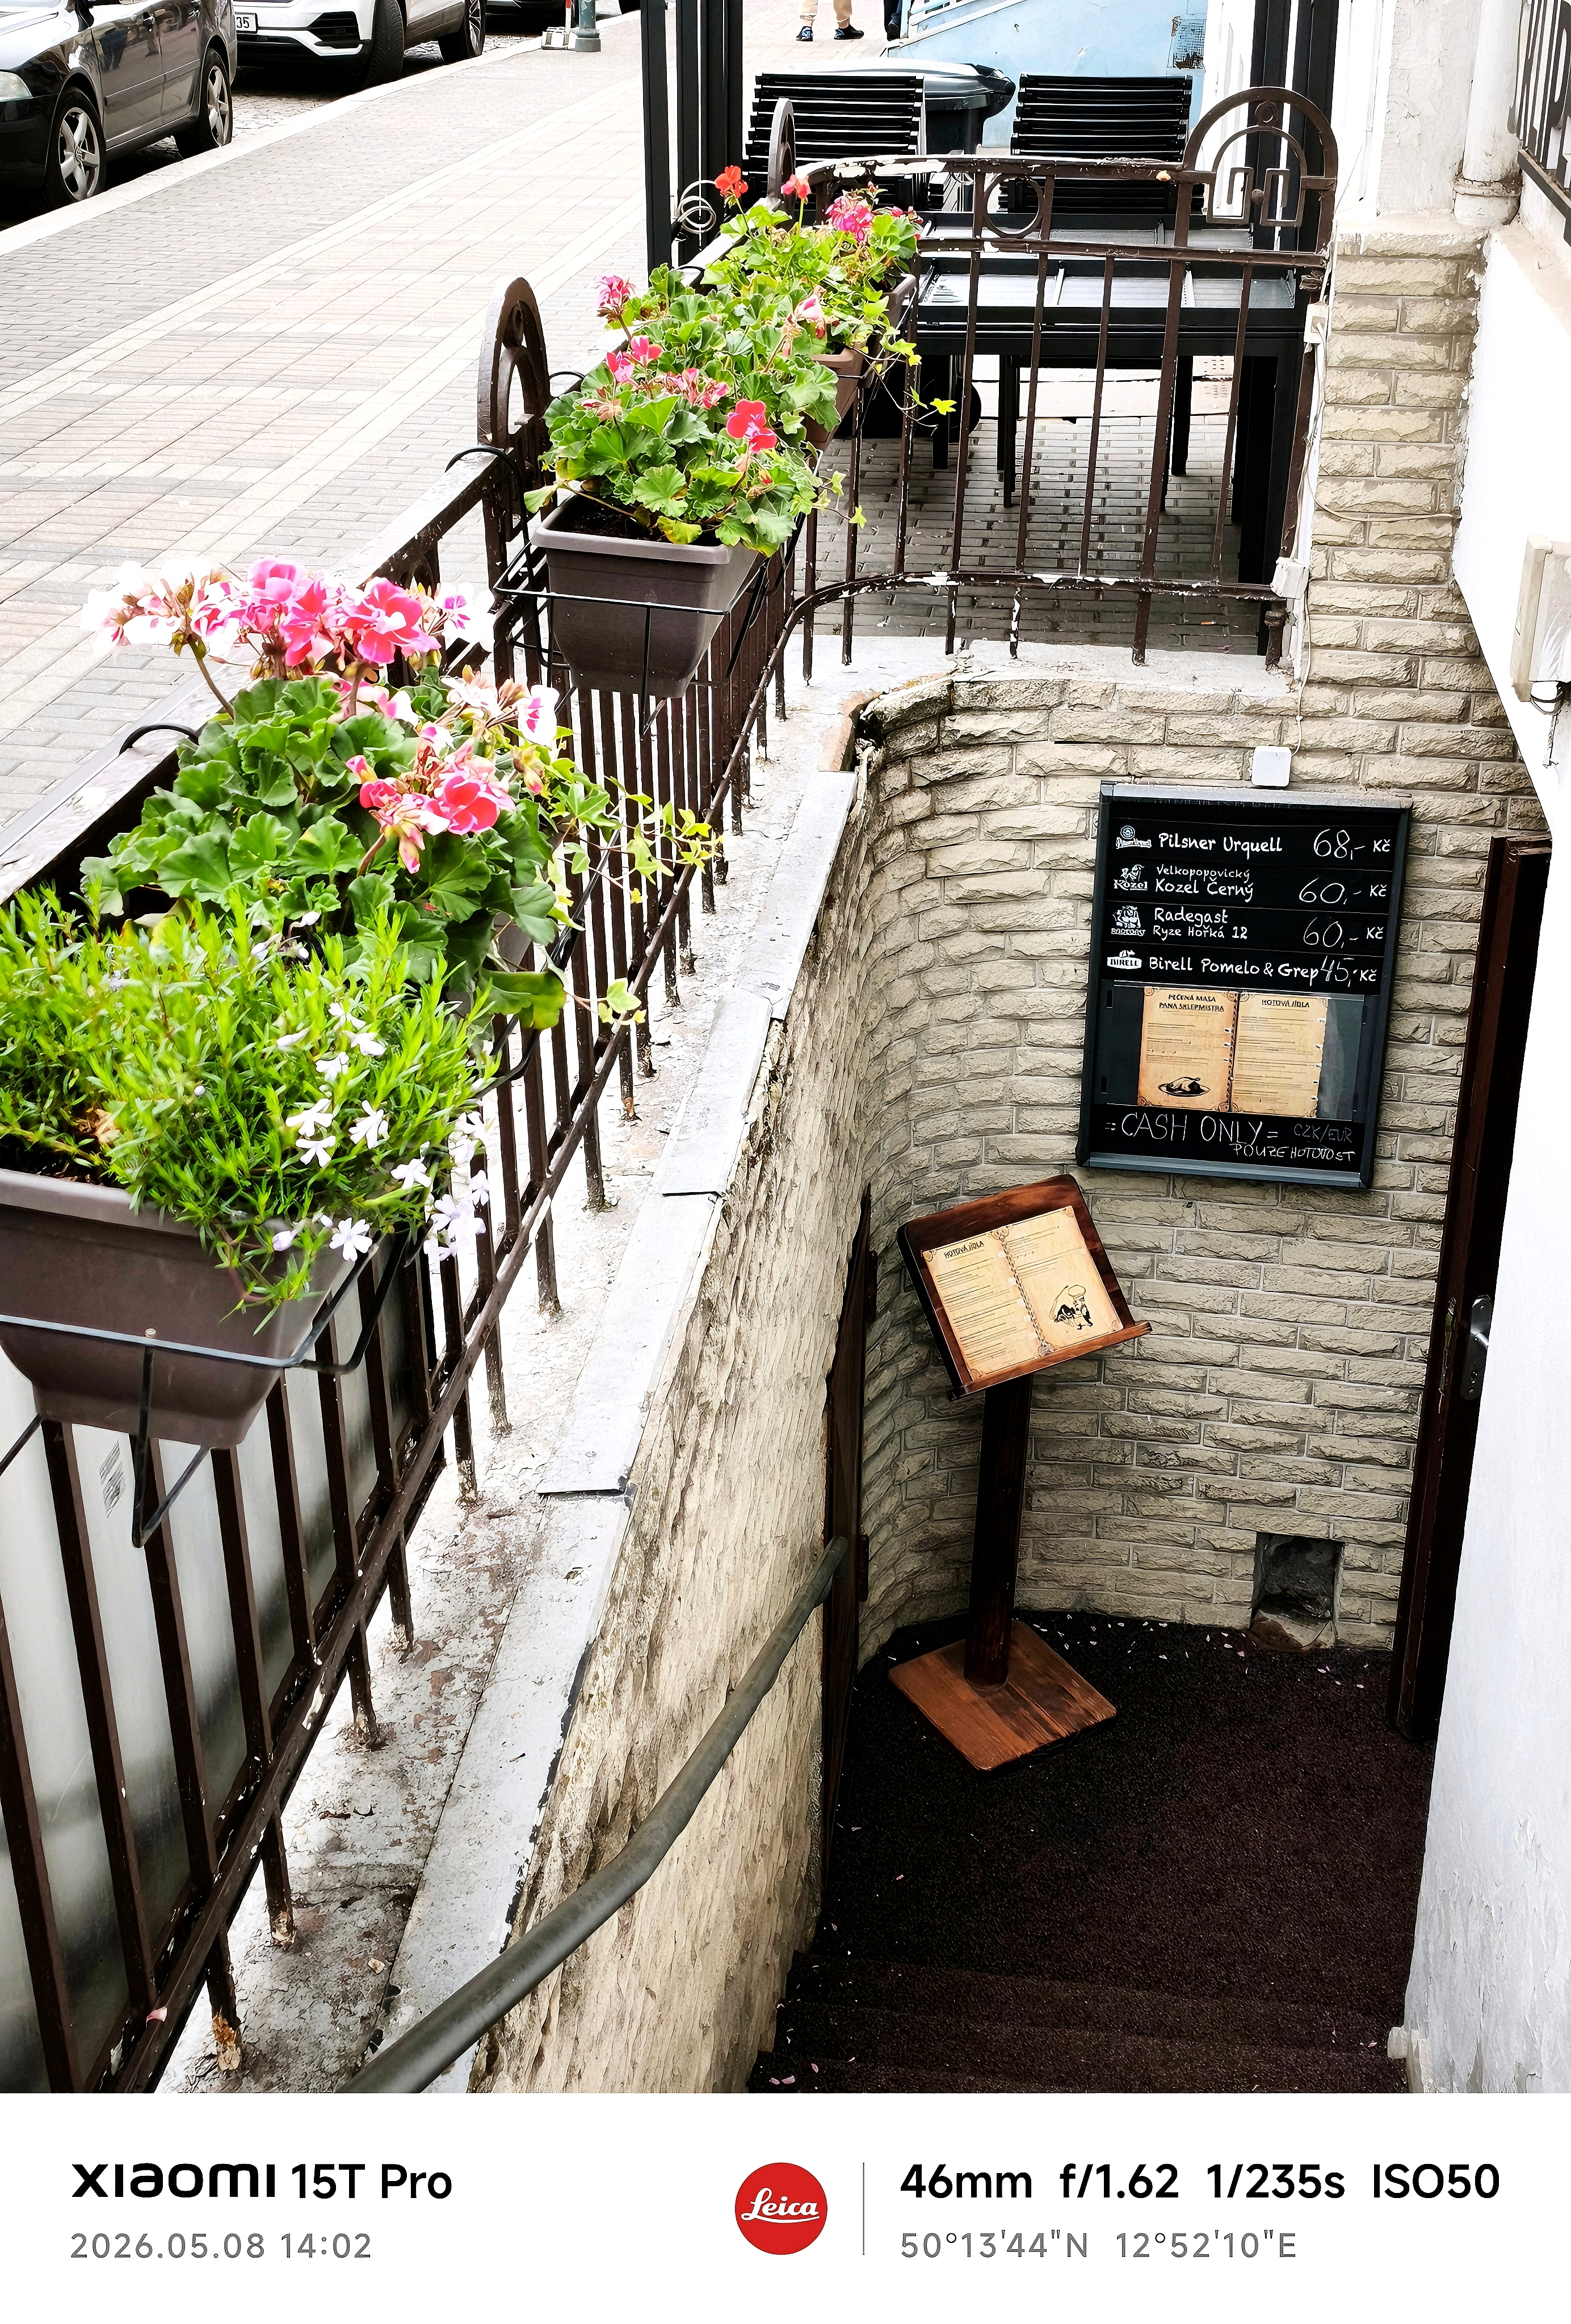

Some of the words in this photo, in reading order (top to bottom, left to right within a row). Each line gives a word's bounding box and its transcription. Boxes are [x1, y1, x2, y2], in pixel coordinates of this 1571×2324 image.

[1158, 832, 1216, 851] Pilsner
[1223, 836, 1283, 860] Urquell
[1373, 839, 1391, 853] Kč
[1156, 864, 1250, 884] Velkopopovický
[1155, 878, 1199, 894] Kozel
[1207, 877, 1254, 903] Černý
[1370, 884, 1387, 897] Kč
[1154, 906, 1228, 928] Radegast
[1153, 925, 1182, 941] Ryze
[1188, 924, 1225, 938] Hořká
[1231, 926, 1247, 940] 12
[1366, 926, 1384, 940] Kč
[1149, 957, 1193, 971] Birell
[1200, 958, 1260, 974] Pomelo
[1263, 962, 1274, 977] &
[1278, 963, 1319, 987] Grep
[1359, 969, 1377, 982] Kč
[1121, 1112, 1187, 1142] CASH
[1200, 1115, 1263, 1146] ONLY
[1293, 1123, 1353, 1144] CZK/EUR
[1229, 1143, 1289, 1157] POUZE
